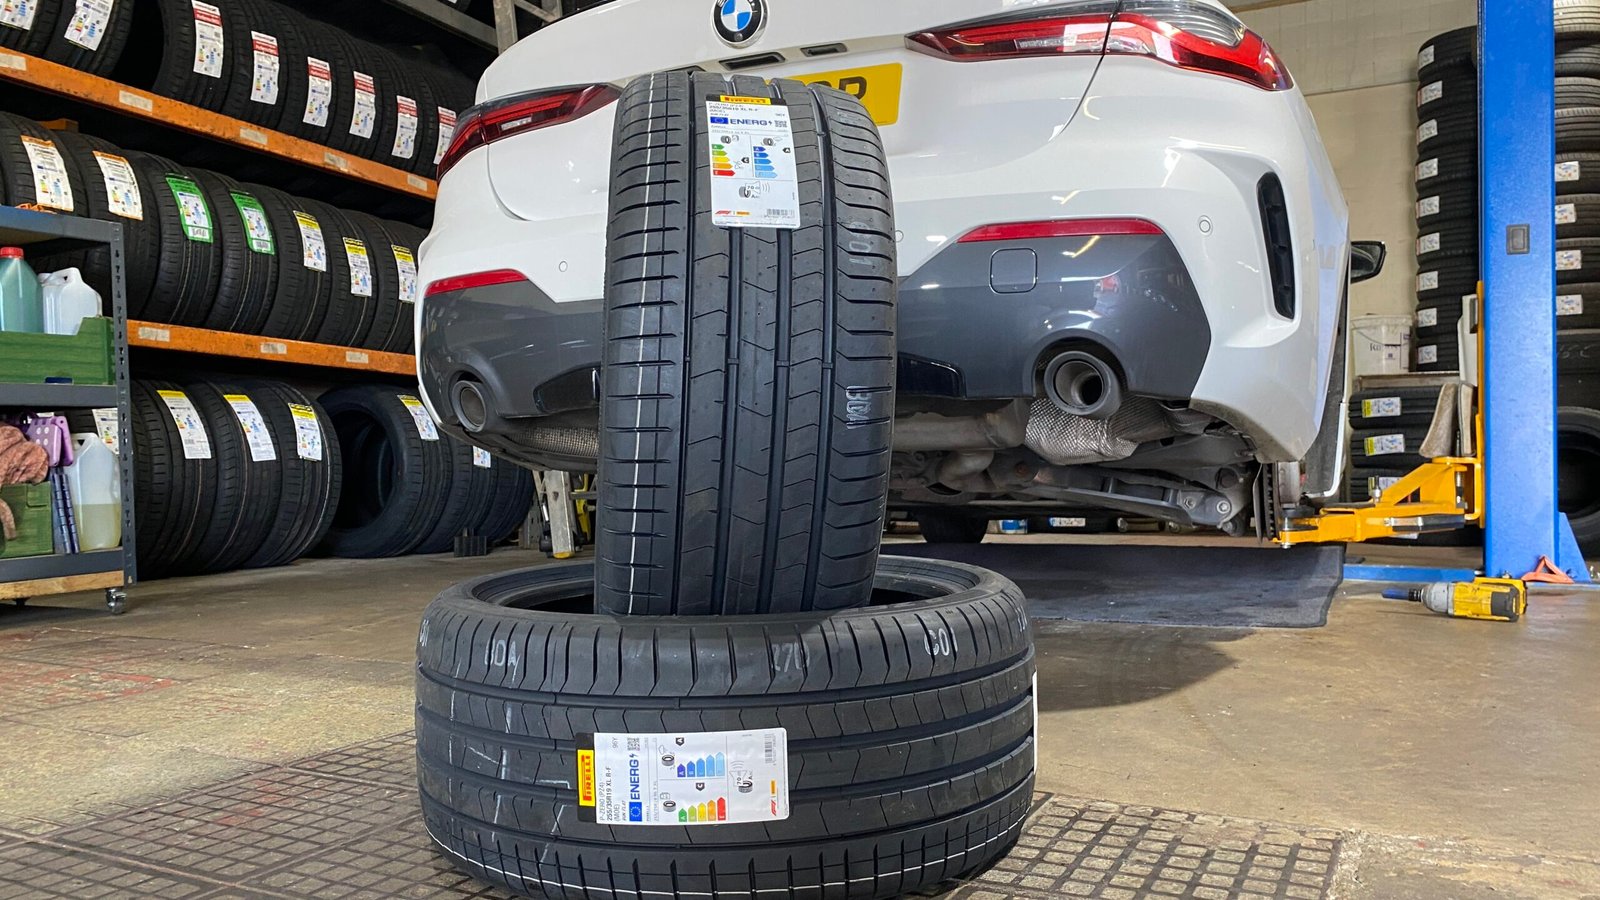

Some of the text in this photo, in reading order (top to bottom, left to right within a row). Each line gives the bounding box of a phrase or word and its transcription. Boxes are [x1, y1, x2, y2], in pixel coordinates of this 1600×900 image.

[582, 755, 592, 801] PIRELLI
[629, 759, 640, 800] ENERG
[598, 798, 606, 821] P-ZERO
[605, 788, 613, 821] 255/35R19
